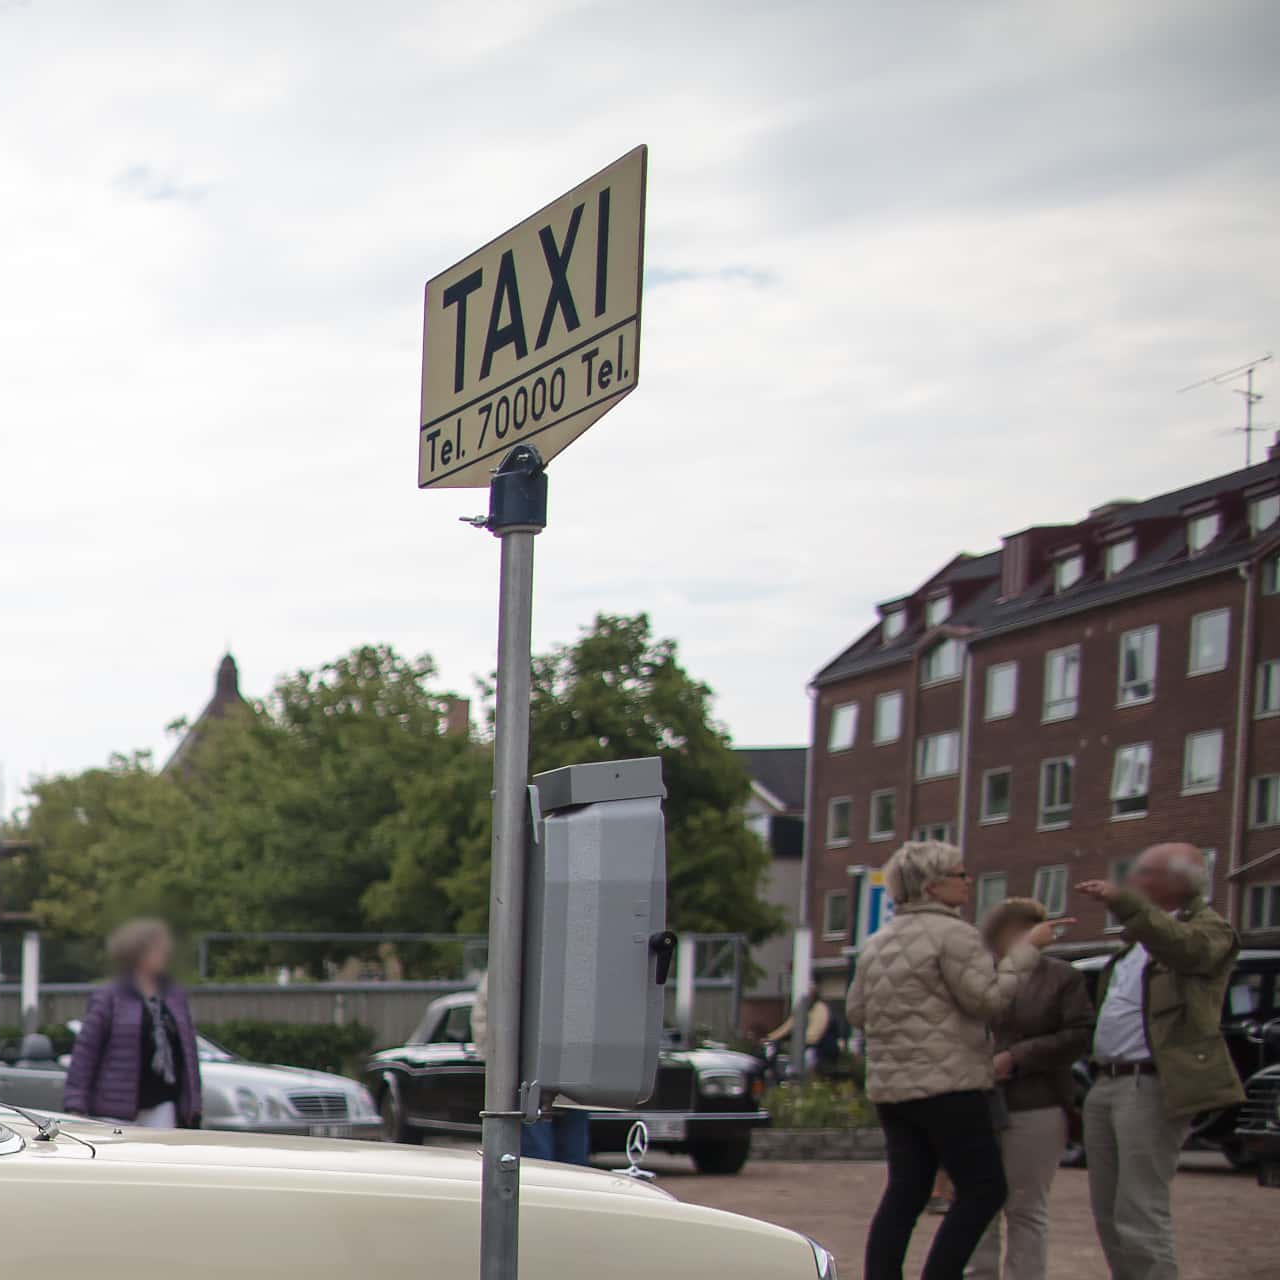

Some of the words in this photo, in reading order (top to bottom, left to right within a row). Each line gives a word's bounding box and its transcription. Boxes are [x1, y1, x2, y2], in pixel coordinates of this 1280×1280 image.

[442, 186, 611, 394] TAXI
[426, 417, 465, 472] Tel.
[477, 367, 566, 449] 70000
[581, 334, 629, 397] Tel.
